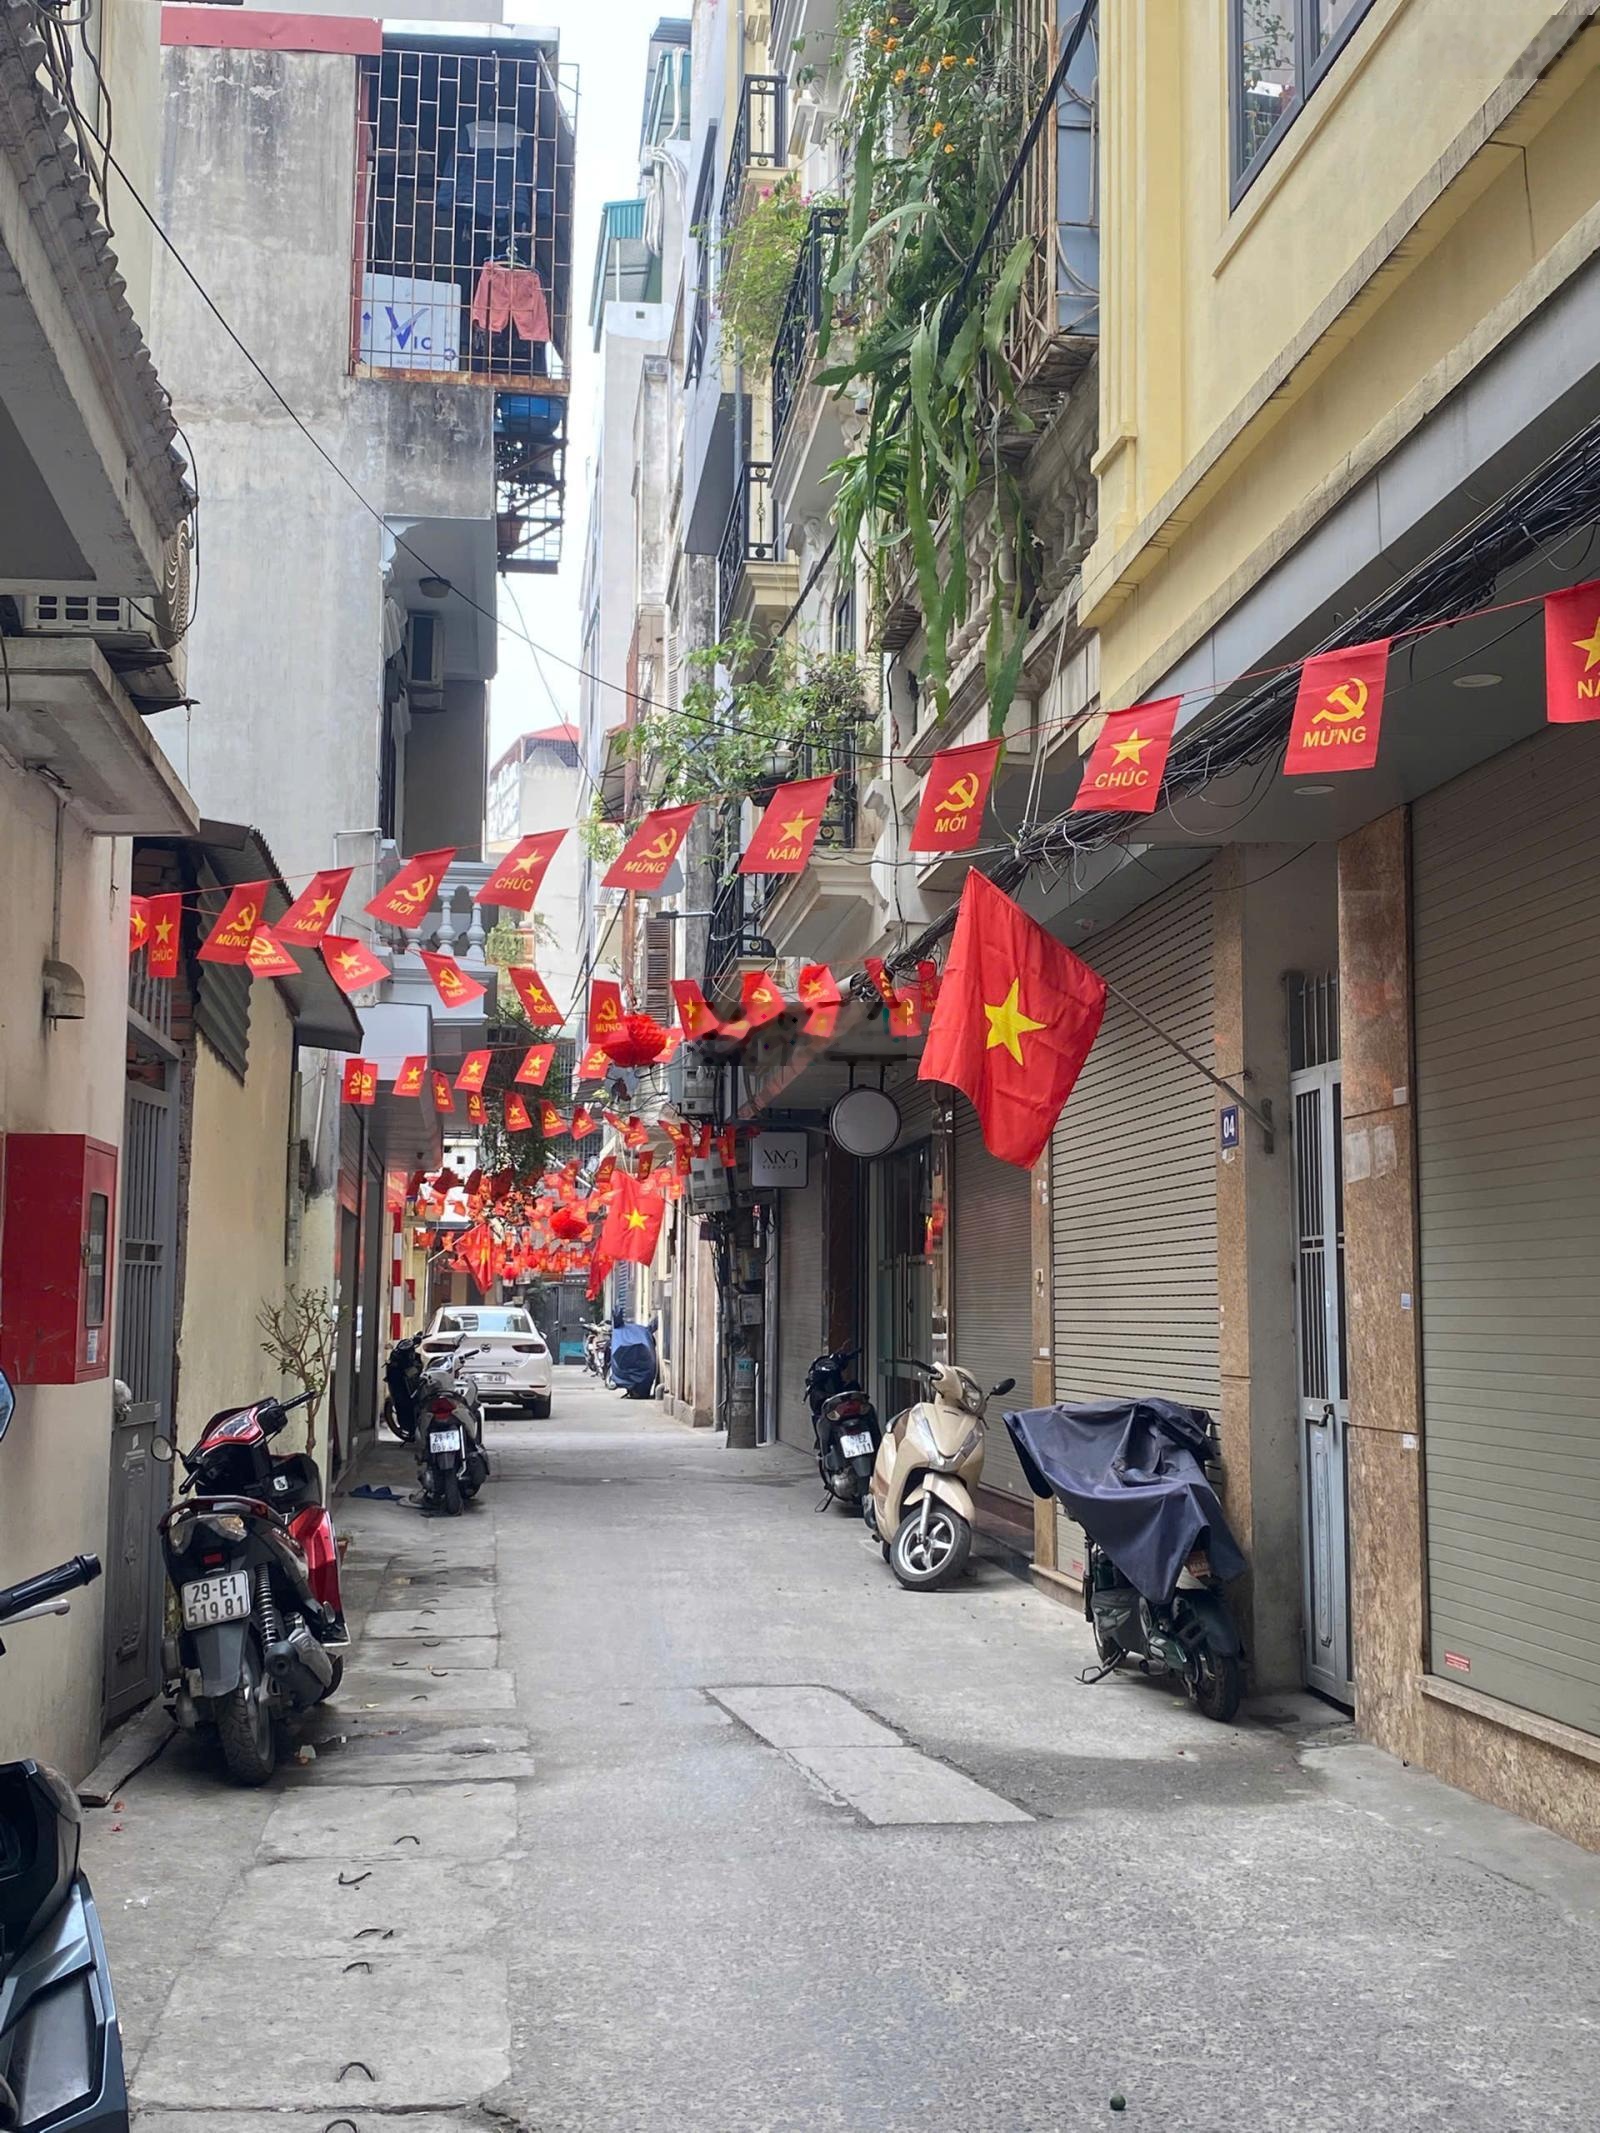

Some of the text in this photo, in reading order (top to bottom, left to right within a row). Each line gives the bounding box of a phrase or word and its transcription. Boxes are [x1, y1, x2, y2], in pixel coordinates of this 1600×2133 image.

[1302, 725, 1367, 748] MỪNG
[1095, 767, 1149, 788] CHÚC
[934, 813, 967, 832] MỚI
[623, 860, 667, 874] MỪNG
[494, 874, 534, 891] CHÚC
[386, 898, 416, 915] MỚI
[215, 932, 251, 947] MỪNG
[1223, 1114, 1235, 1138] 04
[192, 1576, 237, 1604] 29-E1
[188, 1595, 244, 1624] 519.81
